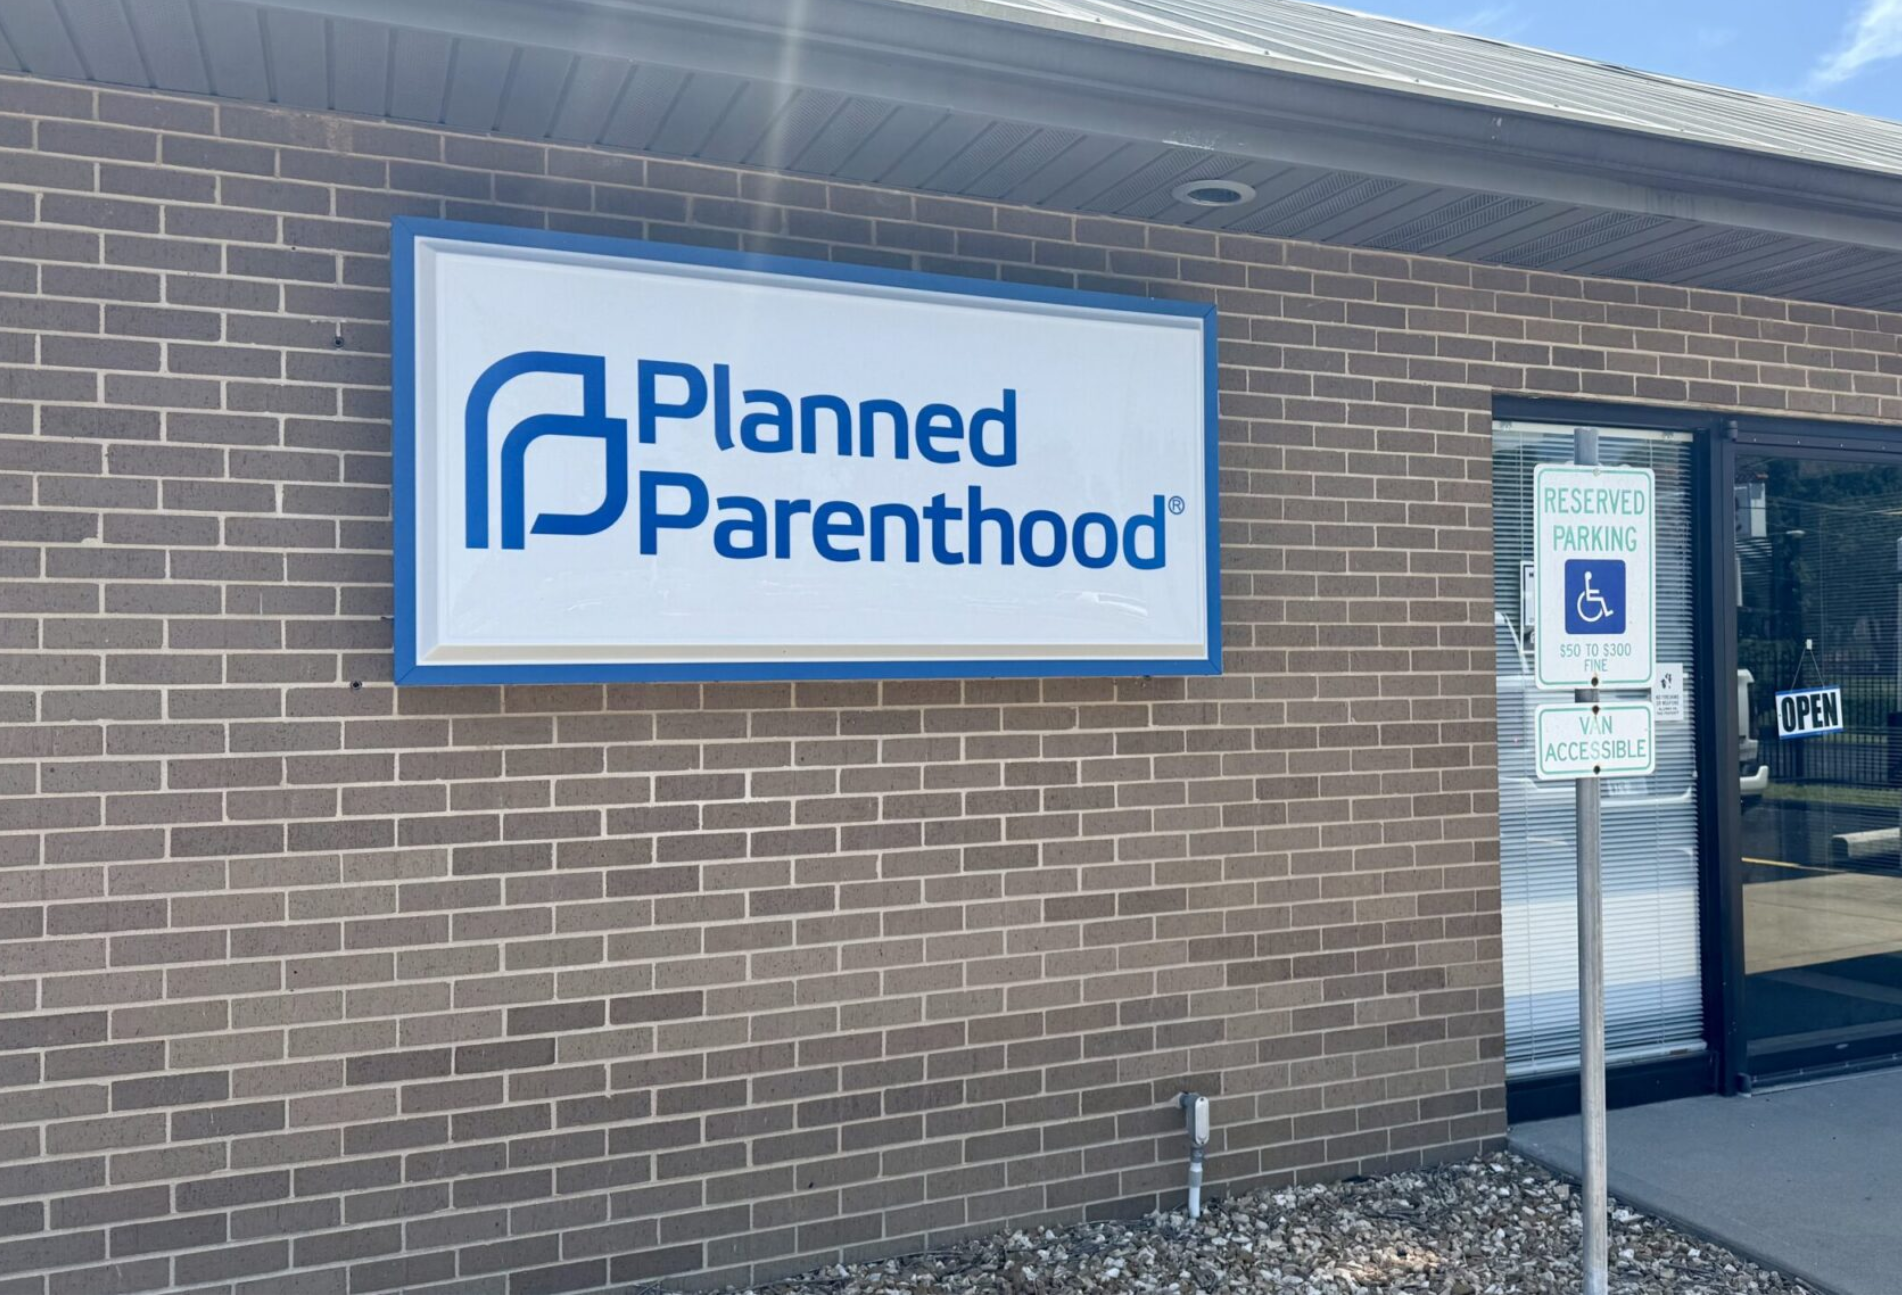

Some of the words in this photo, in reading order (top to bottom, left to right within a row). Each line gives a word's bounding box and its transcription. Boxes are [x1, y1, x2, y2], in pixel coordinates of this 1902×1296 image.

[638, 359, 1017, 468] Planned
[1544, 486, 1646, 516] RESERVED
[1553, 525, 1638, 552] PARKING
[1560, 643, 1582, 658] $50
[1585, 643, 1600, 657] TO
[1603, 643, 1632, 657] $300
[1584, 658, 1608, 672] FINE
[1781, 692, 1839, 732] OPEN
[1579, 716, 1613, 735] VAN
[1545, 740, 1647, 762] ACCESSIBLE
